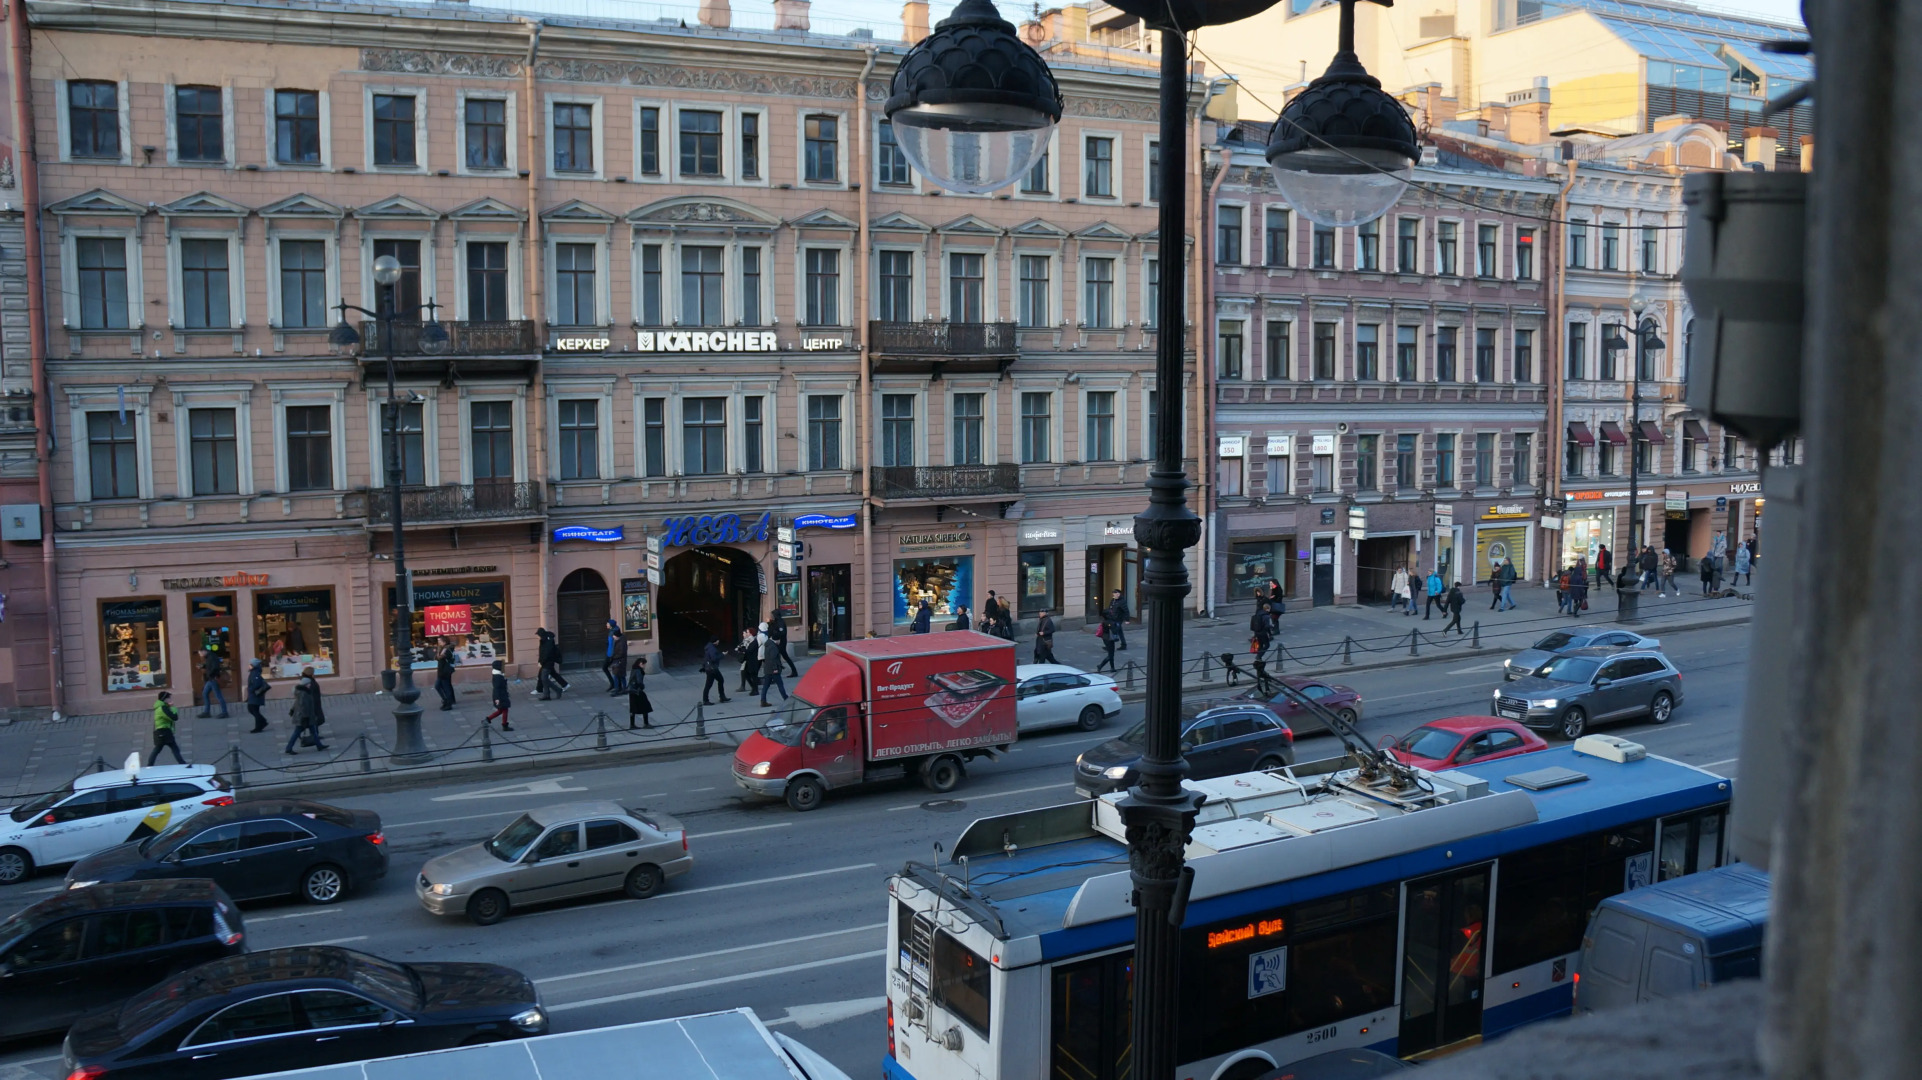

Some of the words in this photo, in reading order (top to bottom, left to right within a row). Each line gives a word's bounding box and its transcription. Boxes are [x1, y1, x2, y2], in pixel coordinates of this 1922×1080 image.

[557, 338, 610, 350] КЕРХЕР
[803, 338, 842, 351] ЦЕНТР
[562, 530, 615, 538] КИНОТЕАТР
[661, 511, 771, 546] НЕВА
[898, 534, 934, 544] NATURA
[935, 532, 971, 543] SIBERICA
[161, 576, 222, 590] THOMAS
[413, 591, 451, 600] THOMAS
[269, 599, 296, 607] THOMAS
[106, 608, 136, 616] THOMAS
[430, 611, 466, 620] THOMAS
[875, 748, 902, 757] ЛЕГКО
[946, 738, 972, 748] ЛЕГКО
[1306, 1026, 1337, 1044] 2500
